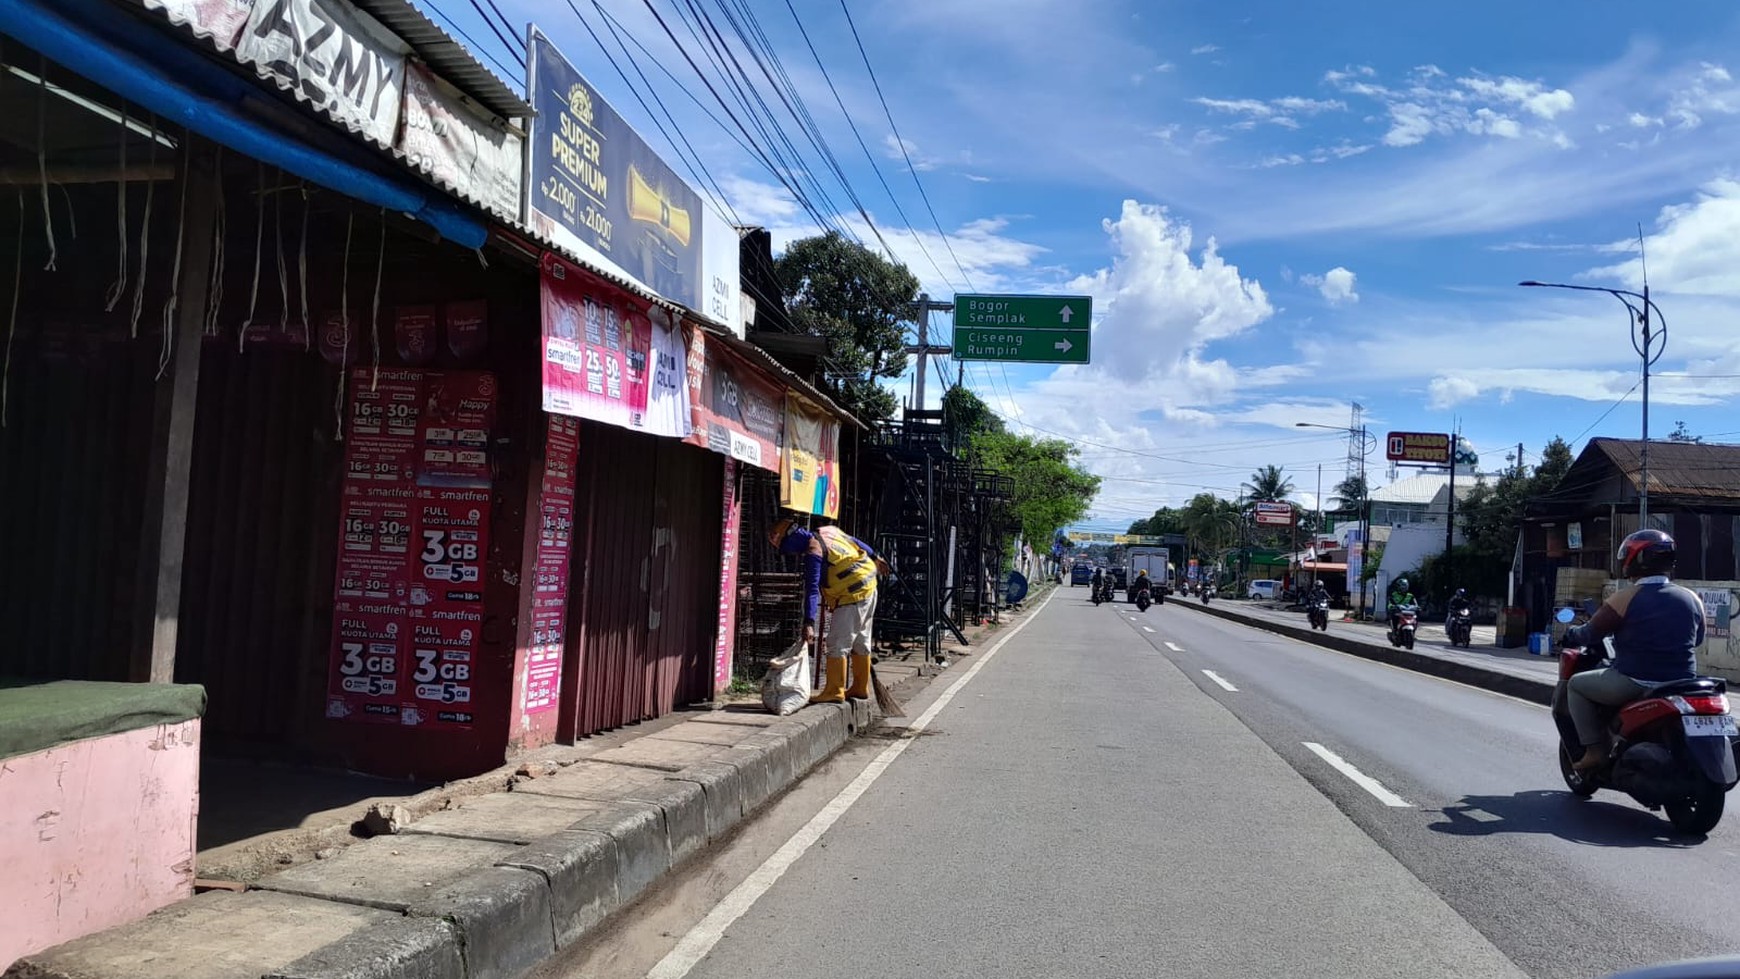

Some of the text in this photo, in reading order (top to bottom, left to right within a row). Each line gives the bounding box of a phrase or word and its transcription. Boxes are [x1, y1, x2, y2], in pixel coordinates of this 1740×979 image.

[560, 111, 600, 166] SUPER
[552, 132, 608, 199] PREMIUM
[969, 300, 1009, 313] Bogor
[969, 313, 1026, 325] Semplak
[968, 332, 1023, 346] Ciseeng
[547, 347, 581, 366] smartfren
[967, 345, 1018, 357] Rumpin
[586, 350, 600, 371] 25
[353, 402, 371, 416] 16
[387, 403, 408, 417] 30
[458, 399, 490, 411] Happy
[349, 461, 362, 471] 16
[374, 462, 389, 472] 30
[367, 487, 415, 498] smartfren
[440, 490, 489, 502] smartfren
[423, 506, 449, 516] FULL
[346, 519, 363, 532] 16
[378, 520, 400, 534] 30
[422, 517, 479, 527] KUOTA UTAMA
[543, 515, 566, 530] 16 30
[420, 529, 478, 563] 3 GB
[450, 563, 464, 582] 5
[464, 569, 476, 577] GB
[341, 578, 354, 589] 16
[365, 580, 380, 590] 30
[358, 604, 406, 615] smartfren
[432, 610, 481, 621] smartfren
[341, 619, 367, 629] FULL
[341, 631, 367, 639] KUOTA
[415, 625, 441, 636] FULL
[414, 637, 471, 647] KUOTA UTAMA
[533, 631, 542, 643] 16
[340, 642, 396, 675] 3 GB
[413, 649, 469, 683] 3 GB
[368, 676, 382, 695] 5
[442, 683, 455, 702] 5
